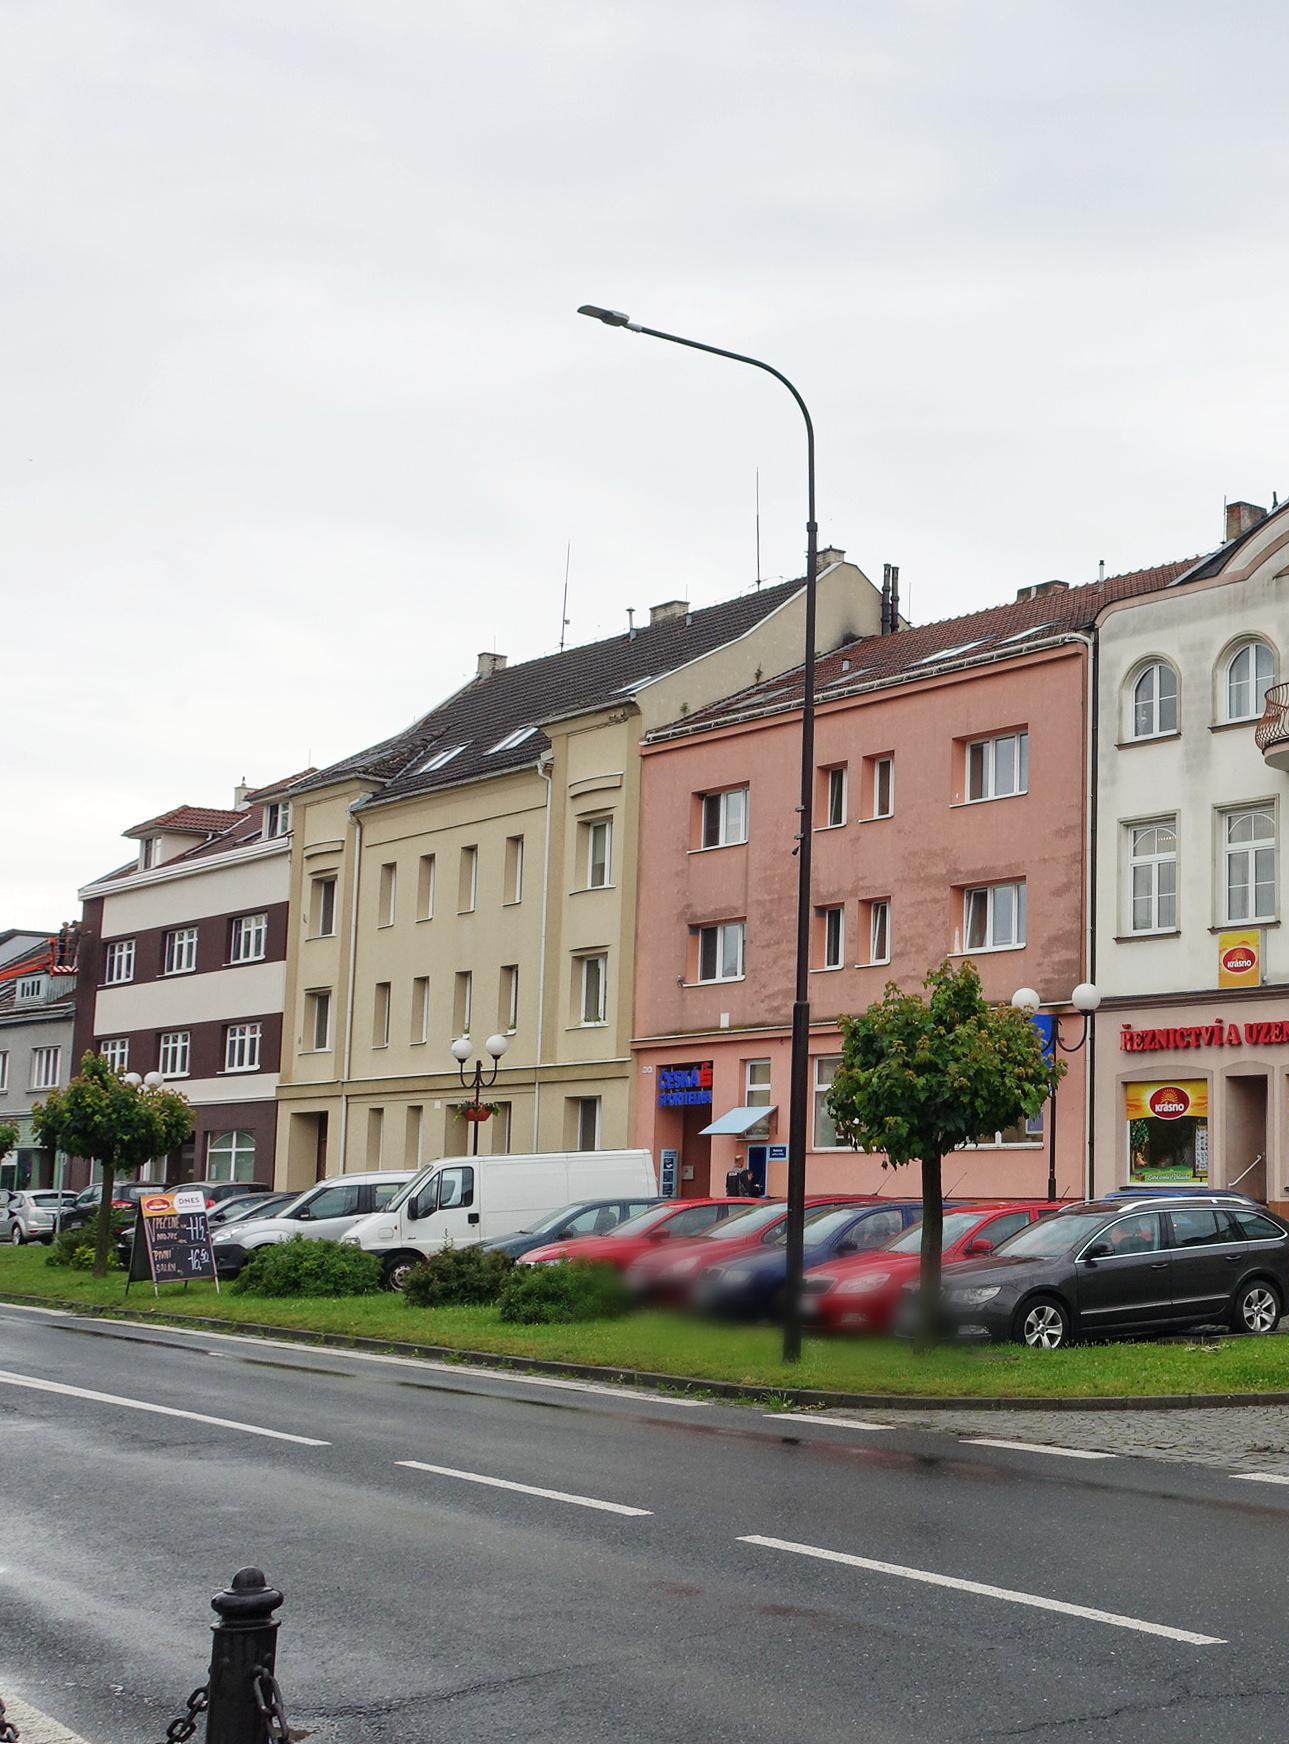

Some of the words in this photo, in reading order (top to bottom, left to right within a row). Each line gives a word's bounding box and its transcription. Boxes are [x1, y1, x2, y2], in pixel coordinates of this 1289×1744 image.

[1120, 1018, 1224, 1052] ŘEZNICTVÍ
[1226, 1024, 1242, 1046] A
[178, 1197, 200, 1205] DNES
